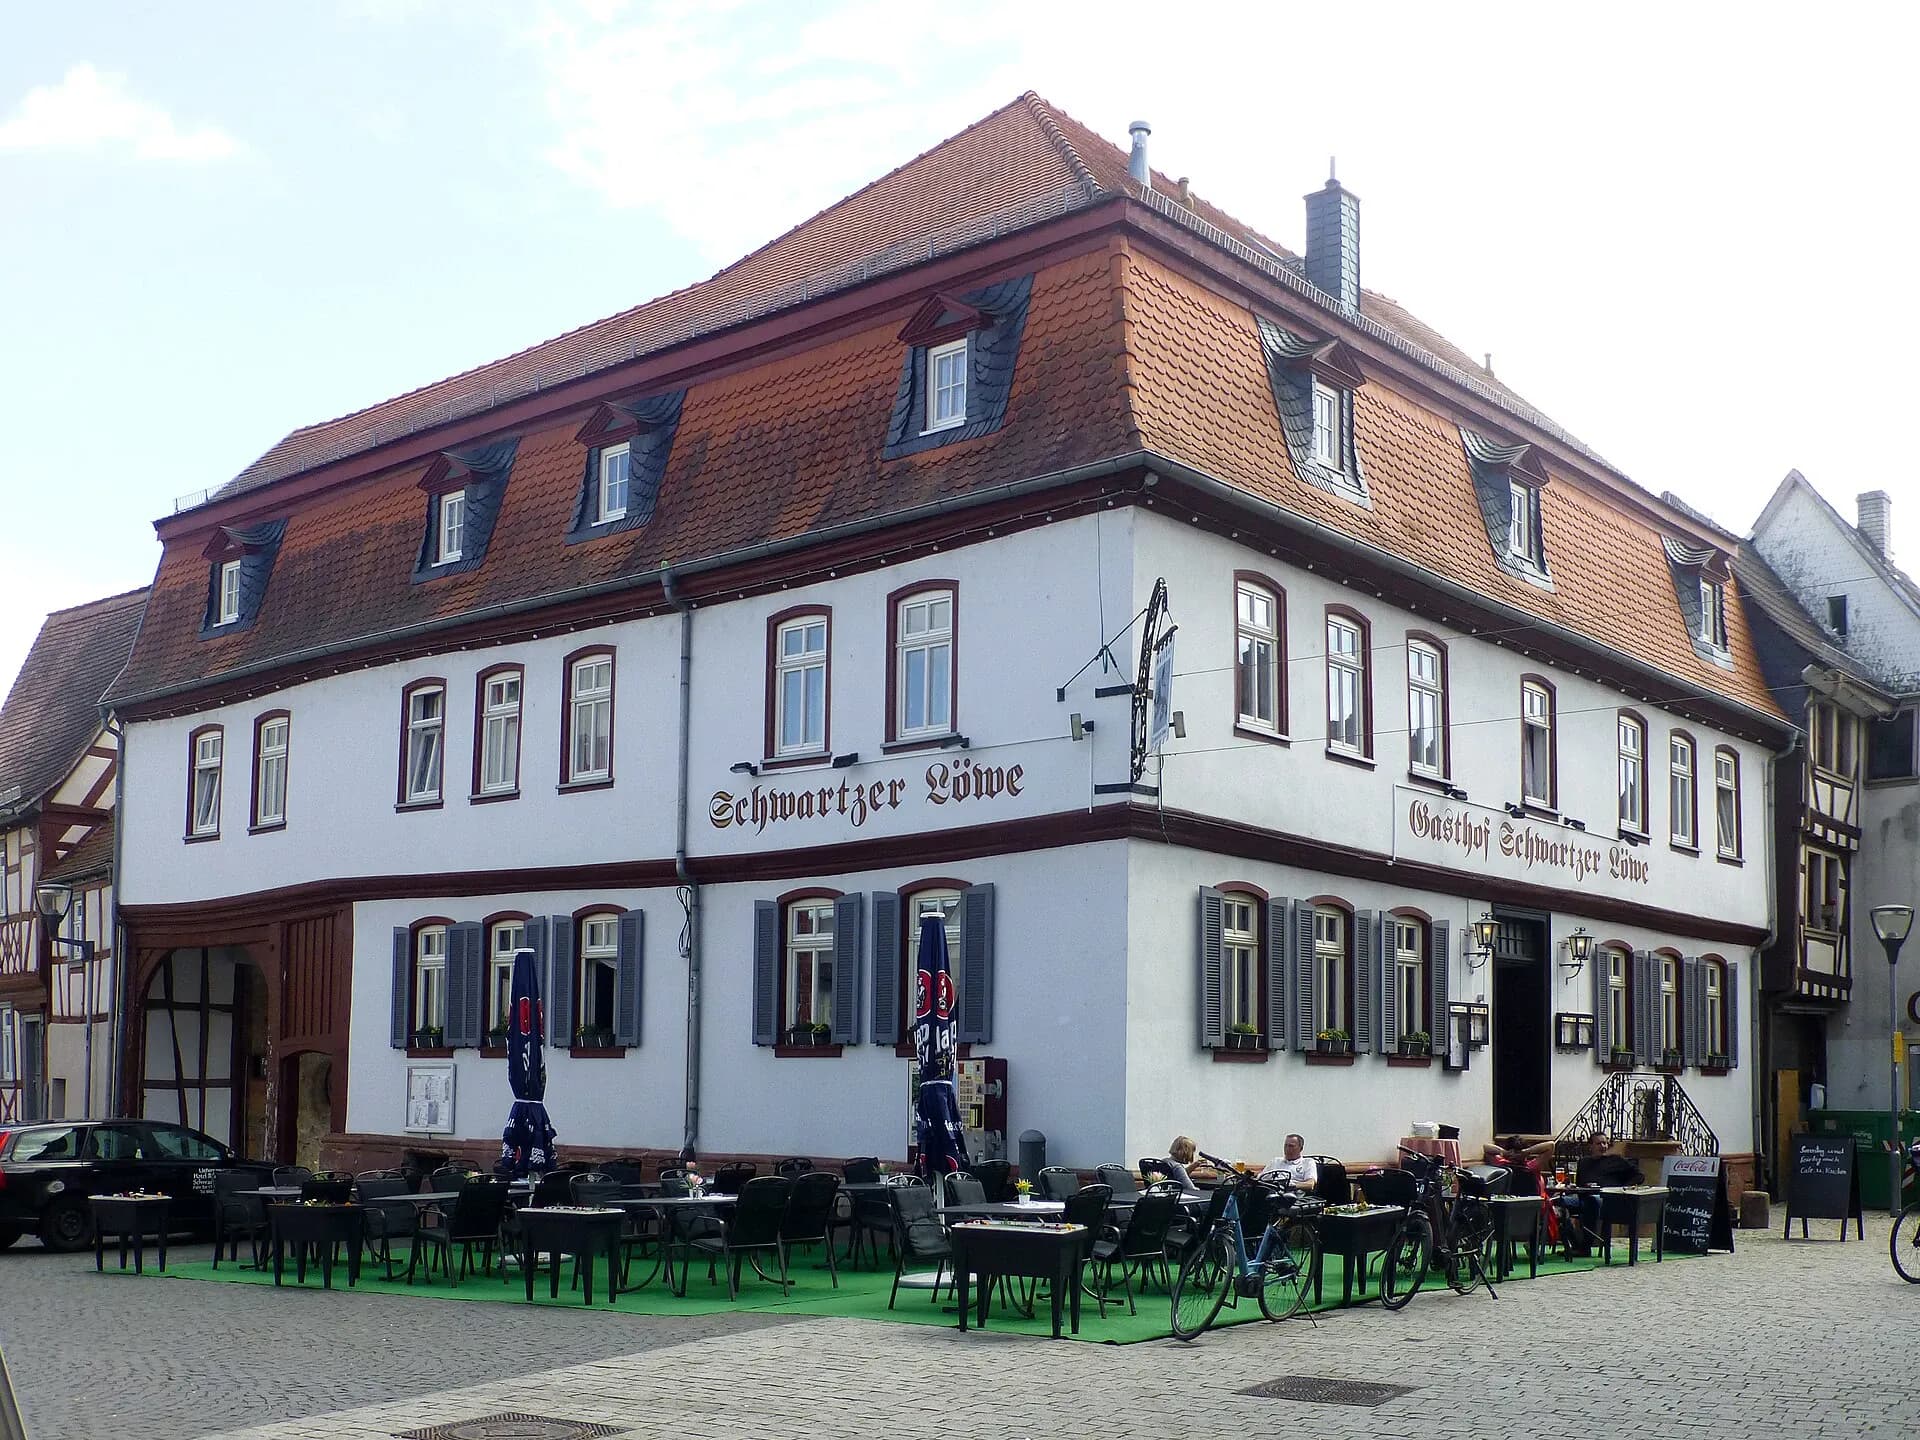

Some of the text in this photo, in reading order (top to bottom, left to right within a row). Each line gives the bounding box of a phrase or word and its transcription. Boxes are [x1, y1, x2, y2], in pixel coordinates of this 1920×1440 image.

[708, 758, 1025, 836] Schwartzer Löwe
[1409, 799, 1648, 885] Gasthof Schwartzer Löwe
